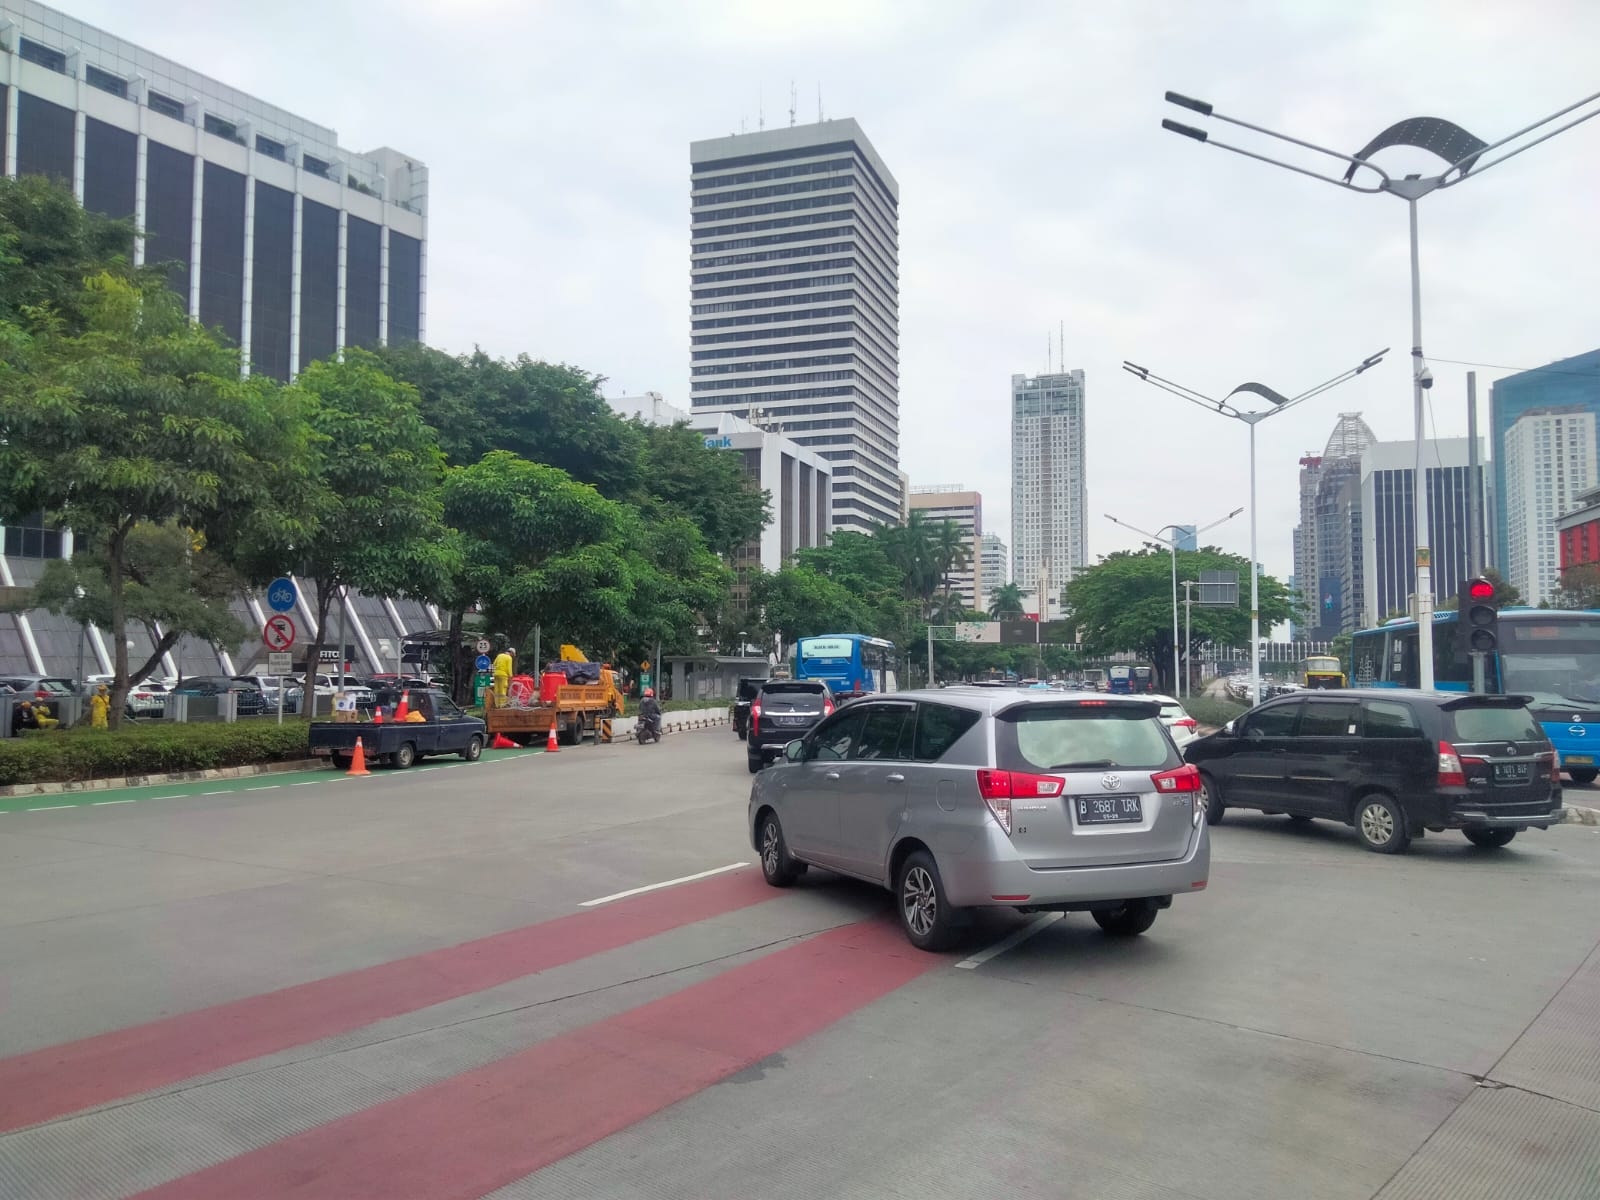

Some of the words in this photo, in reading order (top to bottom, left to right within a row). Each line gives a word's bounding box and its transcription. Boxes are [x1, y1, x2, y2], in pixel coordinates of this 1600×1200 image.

[704, 436, 732, 449] ank
[1080, 800, 1087, 814] B
[1092, 800, 1116, 813] 2687
